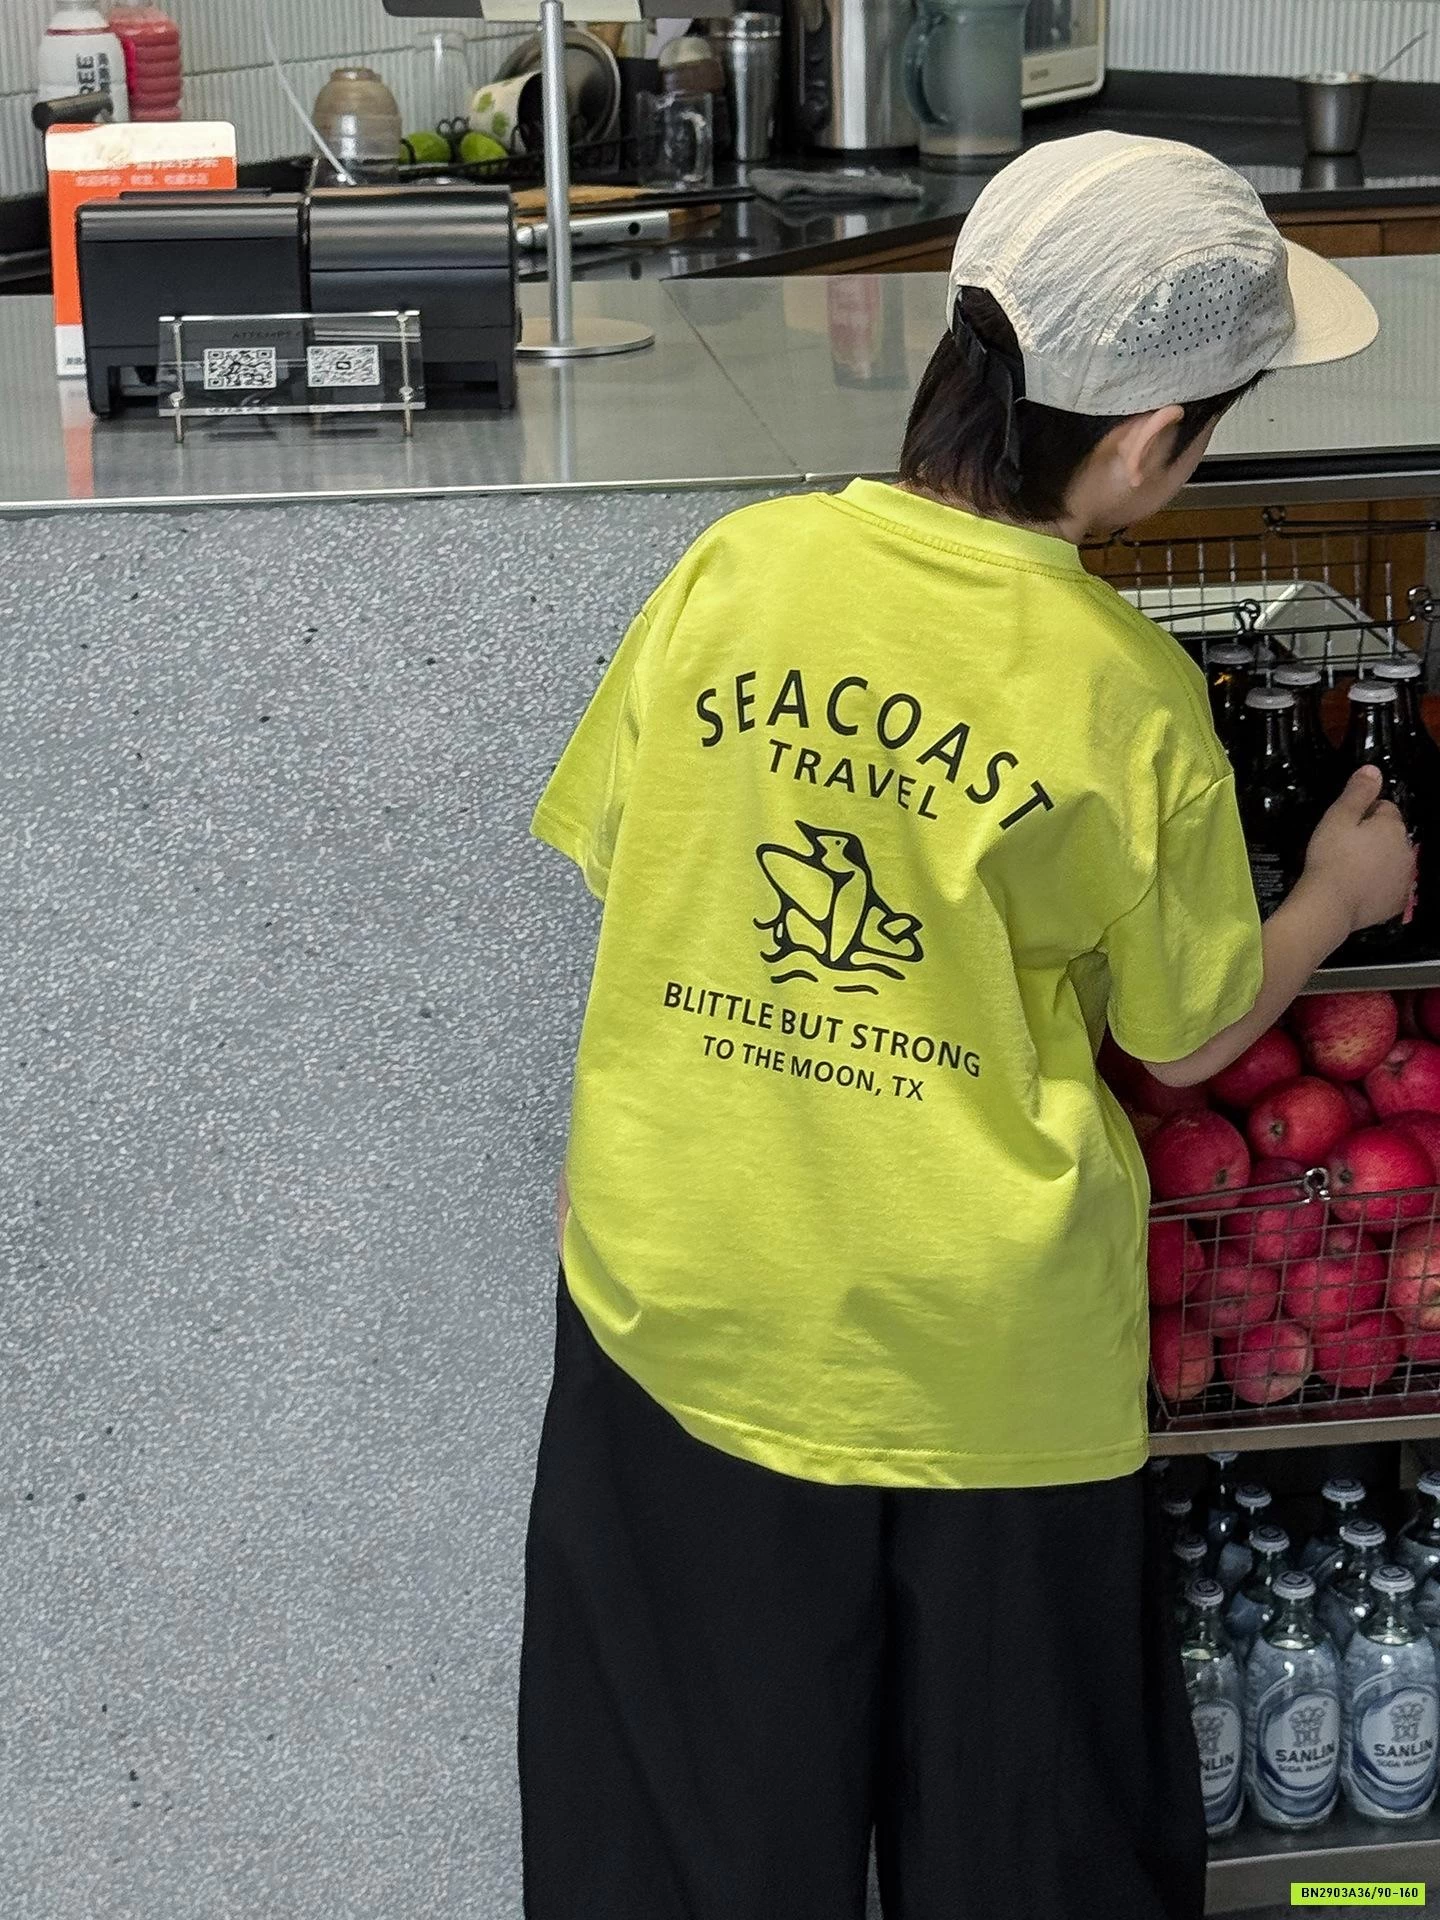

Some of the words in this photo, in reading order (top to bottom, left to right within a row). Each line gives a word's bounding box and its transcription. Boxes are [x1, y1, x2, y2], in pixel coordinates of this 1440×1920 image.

[696, 669, 1055, 831] SEACOAST
[768, 739, 939, 820] TRAVEL
[663, 982, 774, 1029] BLITTLE
[780, 1008, 844, 1044] BUT
[850, 1023, 982, 1078] STRONG
[703, 1035, 735, 1061] TO
[742, 1043, 785, 1073] THE
[790, 1056, 882, 1094] MOON,
[892, 1075, 924, 1101] TX
[1275, 1742, 1336, 1763] SANLIN
[1373, 1739, 1434, 1758] SANLIN
